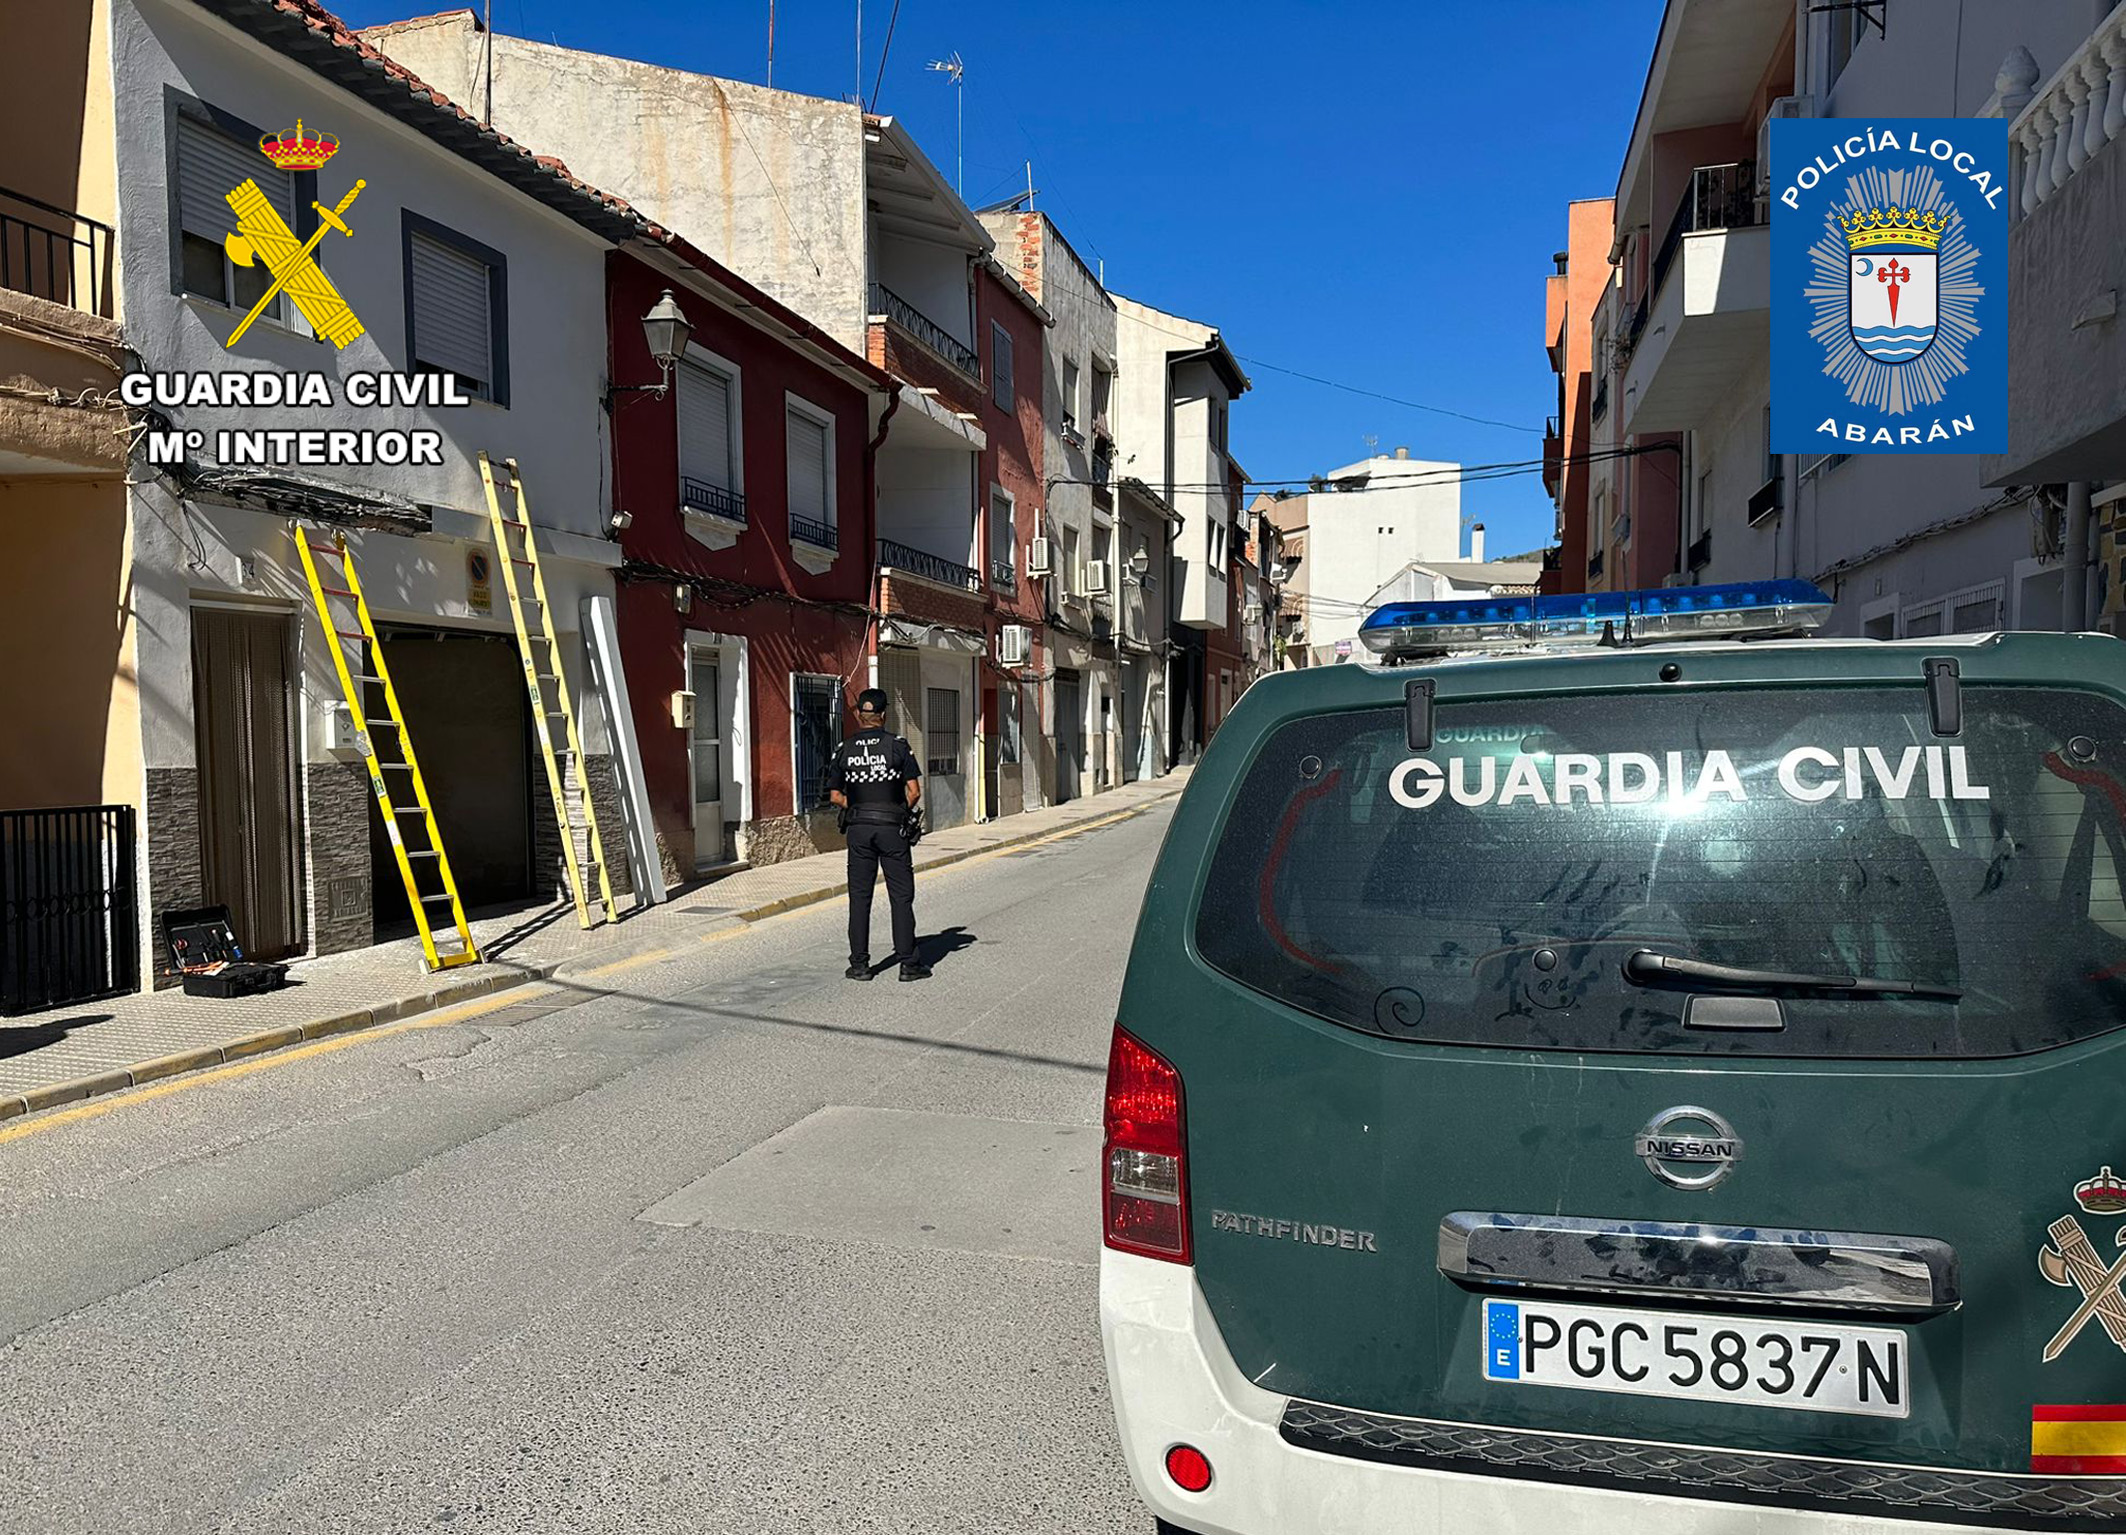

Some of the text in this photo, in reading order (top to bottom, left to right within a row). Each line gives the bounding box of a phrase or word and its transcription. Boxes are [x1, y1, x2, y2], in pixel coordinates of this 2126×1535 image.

[1388, 746, 1990, 809] GUARDIA CIVIL
[1647, 1141, 1732, 1157] NISSAN
[1211, 1209, 1378, 1252] PATHFINDER
[1496, 1349, 1511, 1366] E
